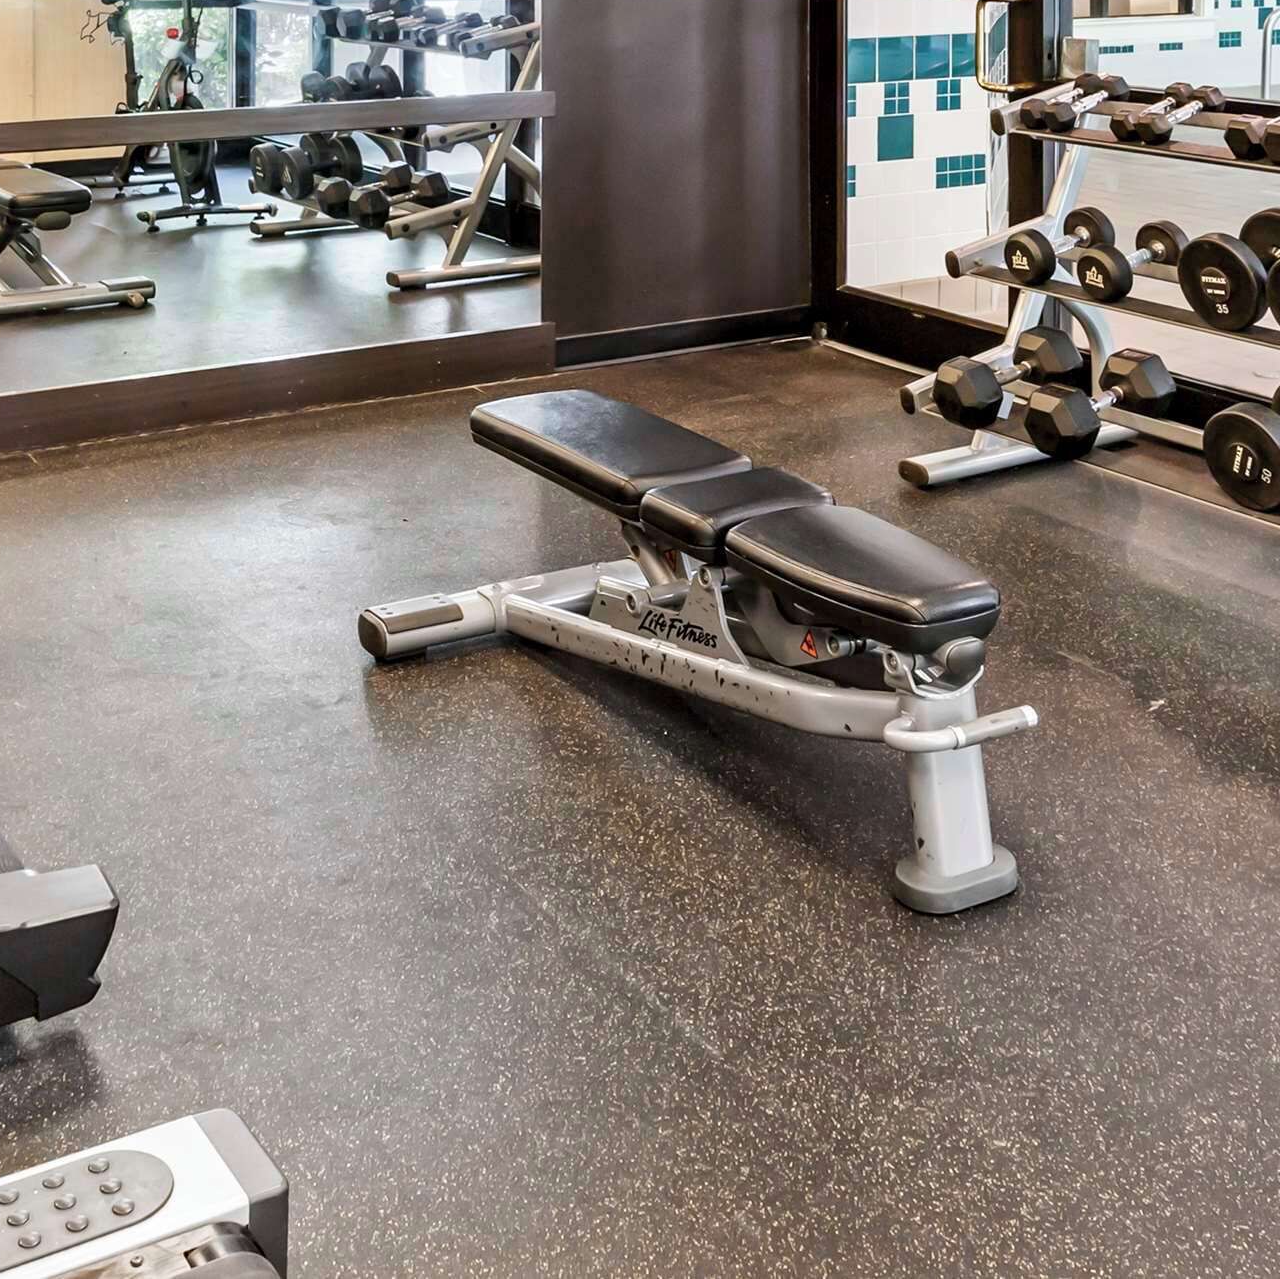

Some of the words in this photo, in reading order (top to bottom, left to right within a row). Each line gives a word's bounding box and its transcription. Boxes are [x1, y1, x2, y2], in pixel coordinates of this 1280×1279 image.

[1201, 275, 1227, 285] FITMAX
[1215, 303, 1229, 315] 35
[1261, 467, 1272, 484] 50
[638, 609, 667, 636] Life
[666, 618, 718, 649] Fitness
